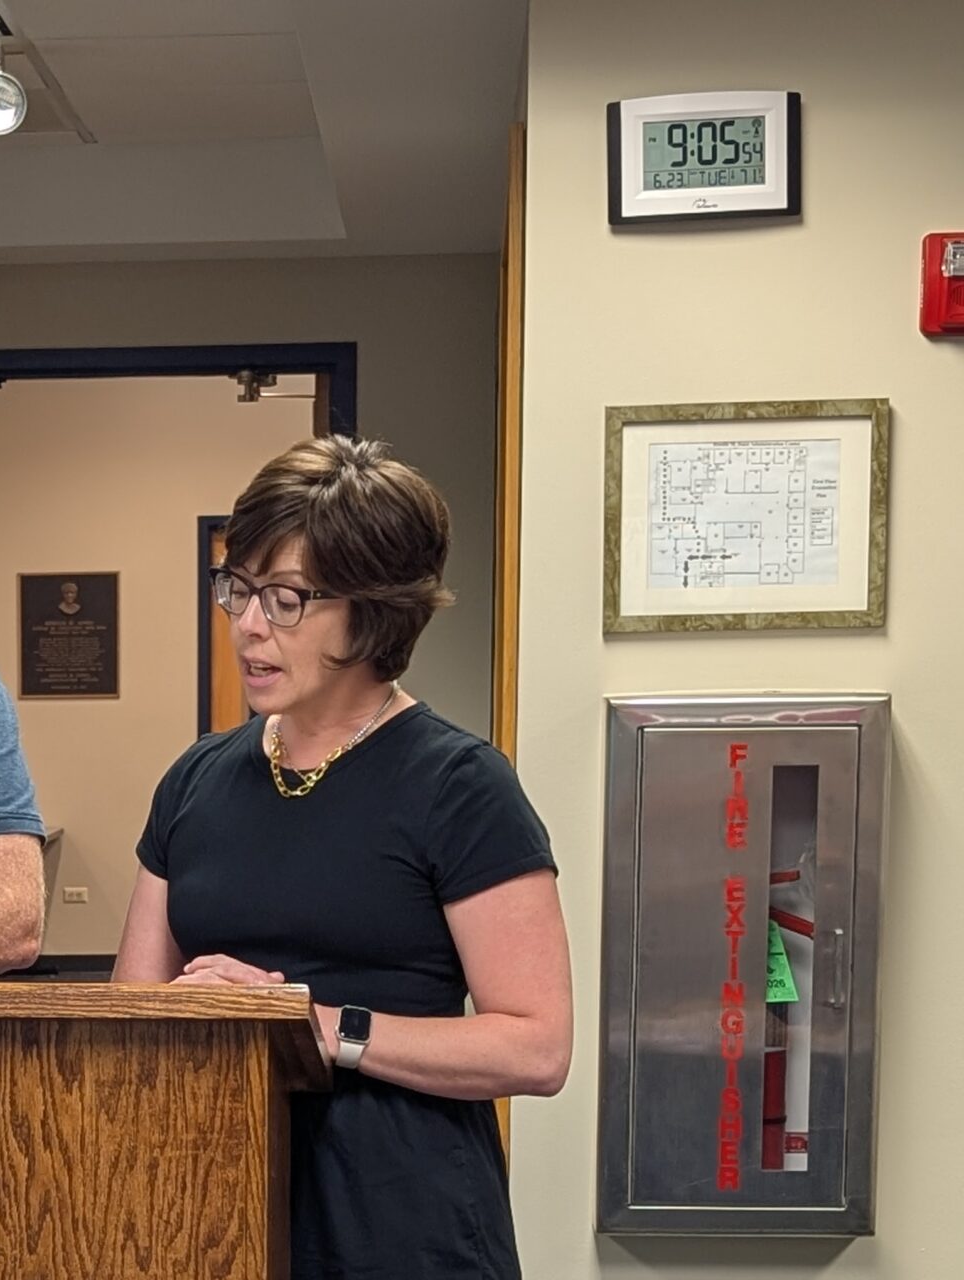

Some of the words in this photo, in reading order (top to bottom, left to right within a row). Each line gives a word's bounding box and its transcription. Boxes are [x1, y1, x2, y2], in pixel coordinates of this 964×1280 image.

[668, 120, 739, 168] 9:05
[742, 141, 764, 164] 54
[699, 169, 727, 186] TUE
[725, 743, 749, 849] FIRE
[767, 979, 786, 988] 026
[717, 877, 747, 1191] EXTINGUISHER
